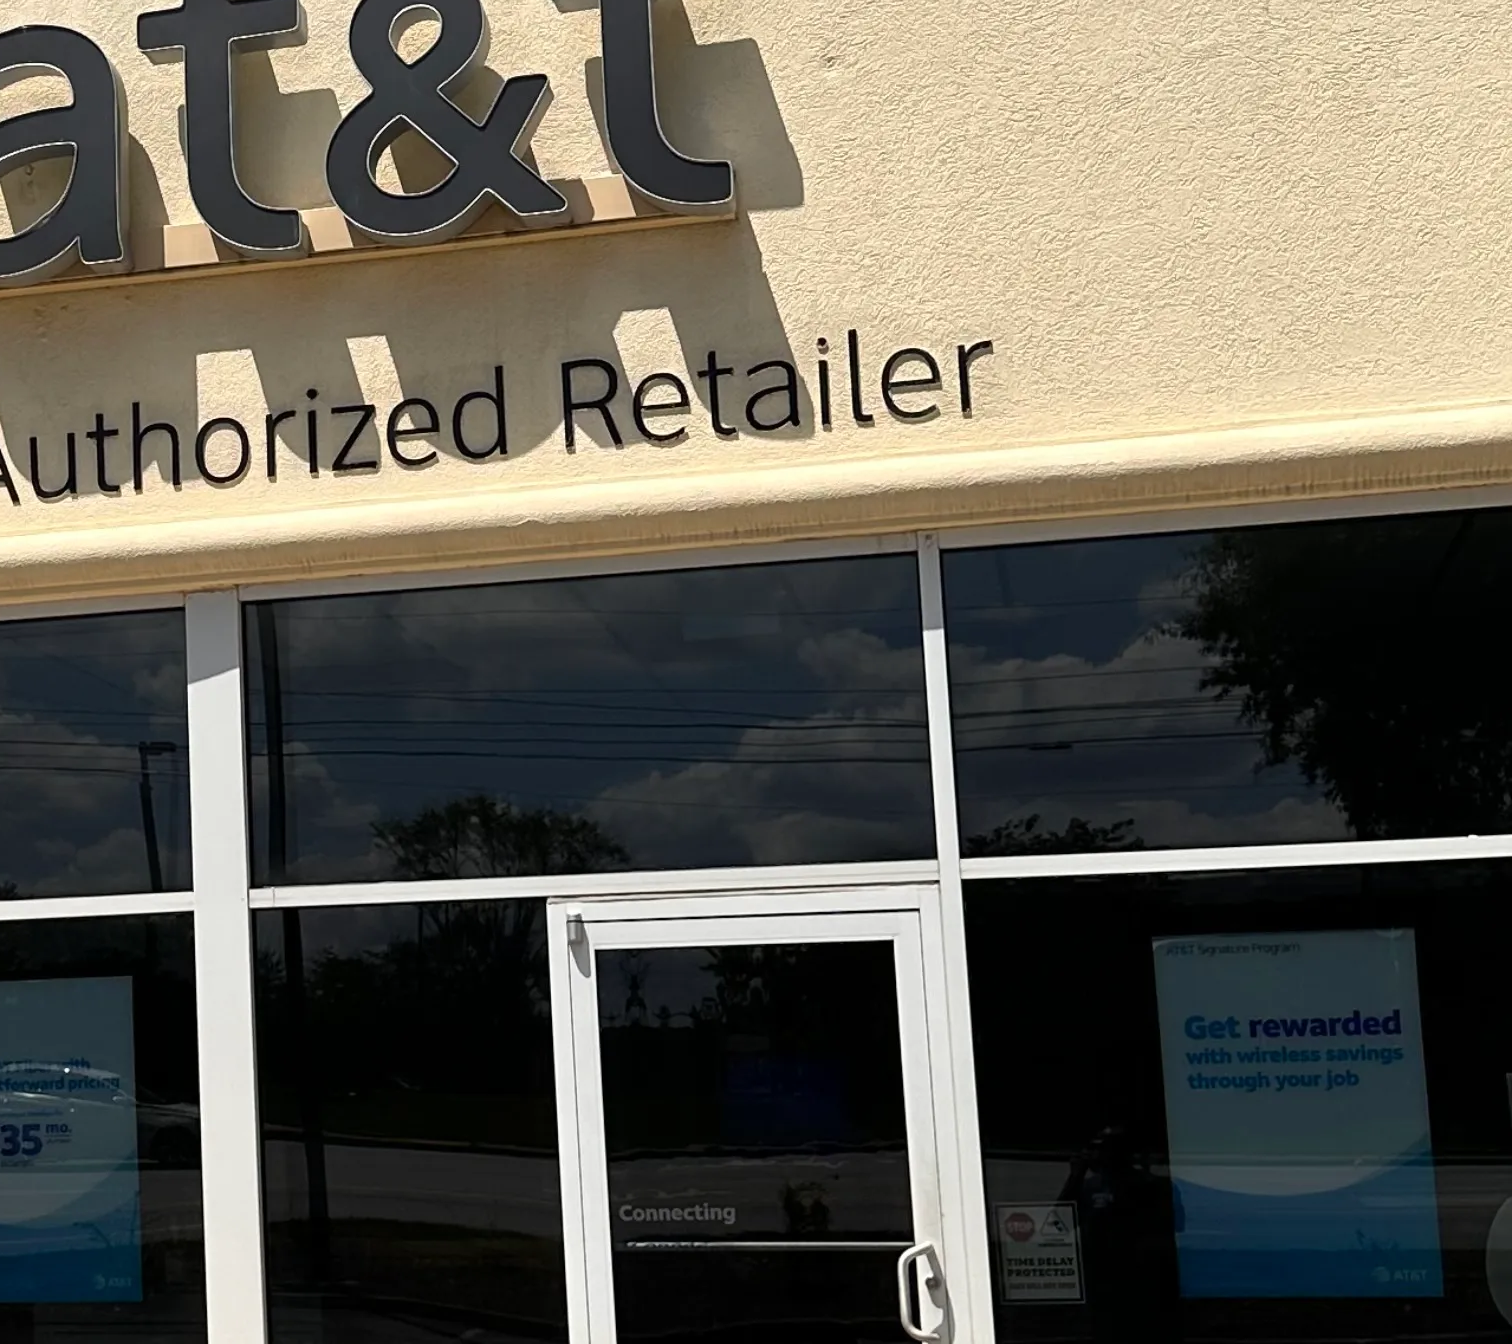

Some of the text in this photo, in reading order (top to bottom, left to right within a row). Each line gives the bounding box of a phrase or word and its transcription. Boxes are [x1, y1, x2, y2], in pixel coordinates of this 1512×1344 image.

[561, 327, 995, 456] Retailer
[1197, 943, 1250, 958] Signature
[1251, 942, 1300, 956] Program
[1185, 1009, 1402, 1040] Get rewarded
[1186, 1044, 1404, 1065] with wireless savings
[1188, 1069, 1359, 1092] through your job
[46, 1123, 72, 1134] mo.
[619, 1202, 737, 1225] Connecting
[1006, 1256, 1074, 1267] TIME DELAY
[1007, 1267, 1075, 1277] PROTECTED
